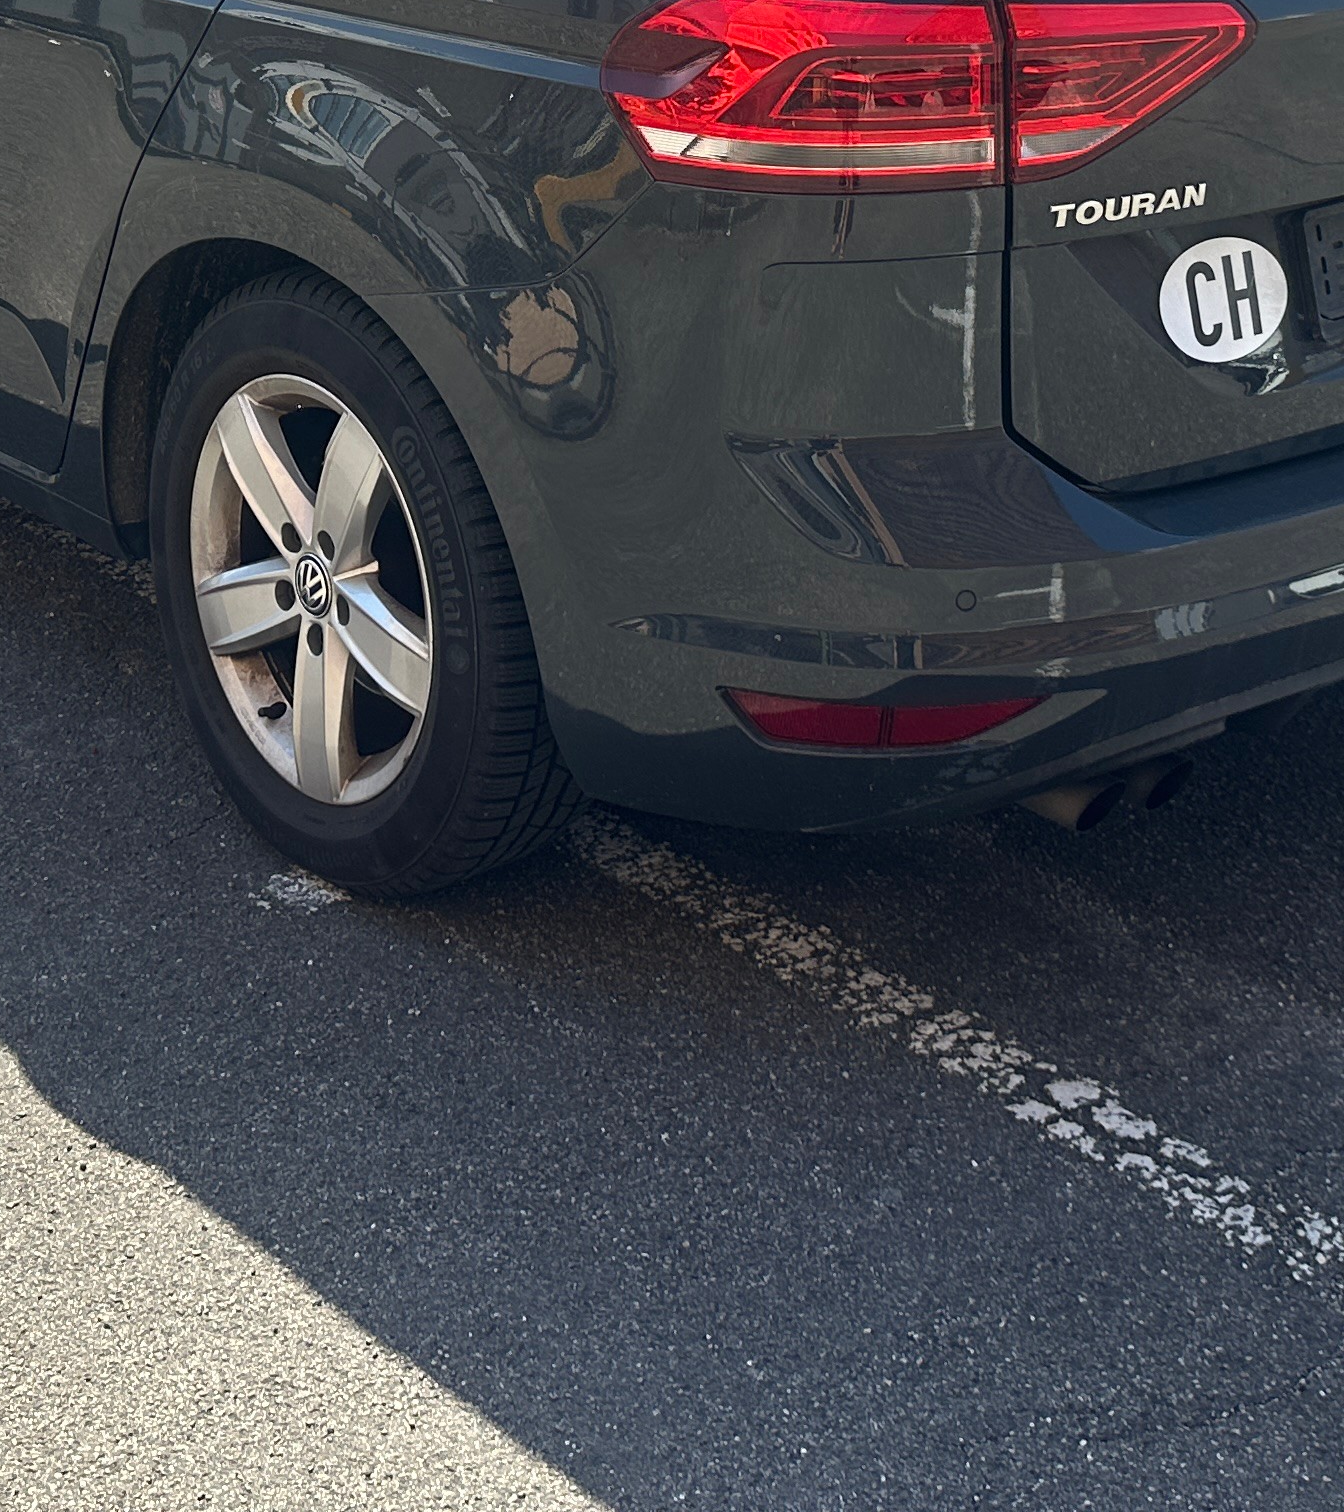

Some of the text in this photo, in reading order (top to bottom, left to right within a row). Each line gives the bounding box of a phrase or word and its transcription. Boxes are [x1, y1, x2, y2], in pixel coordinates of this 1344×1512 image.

[1050, 182, 1207, 228] TOURAN
[1185, 250, 1263, 347] CH
[392, 425, 469, 640] Continental
